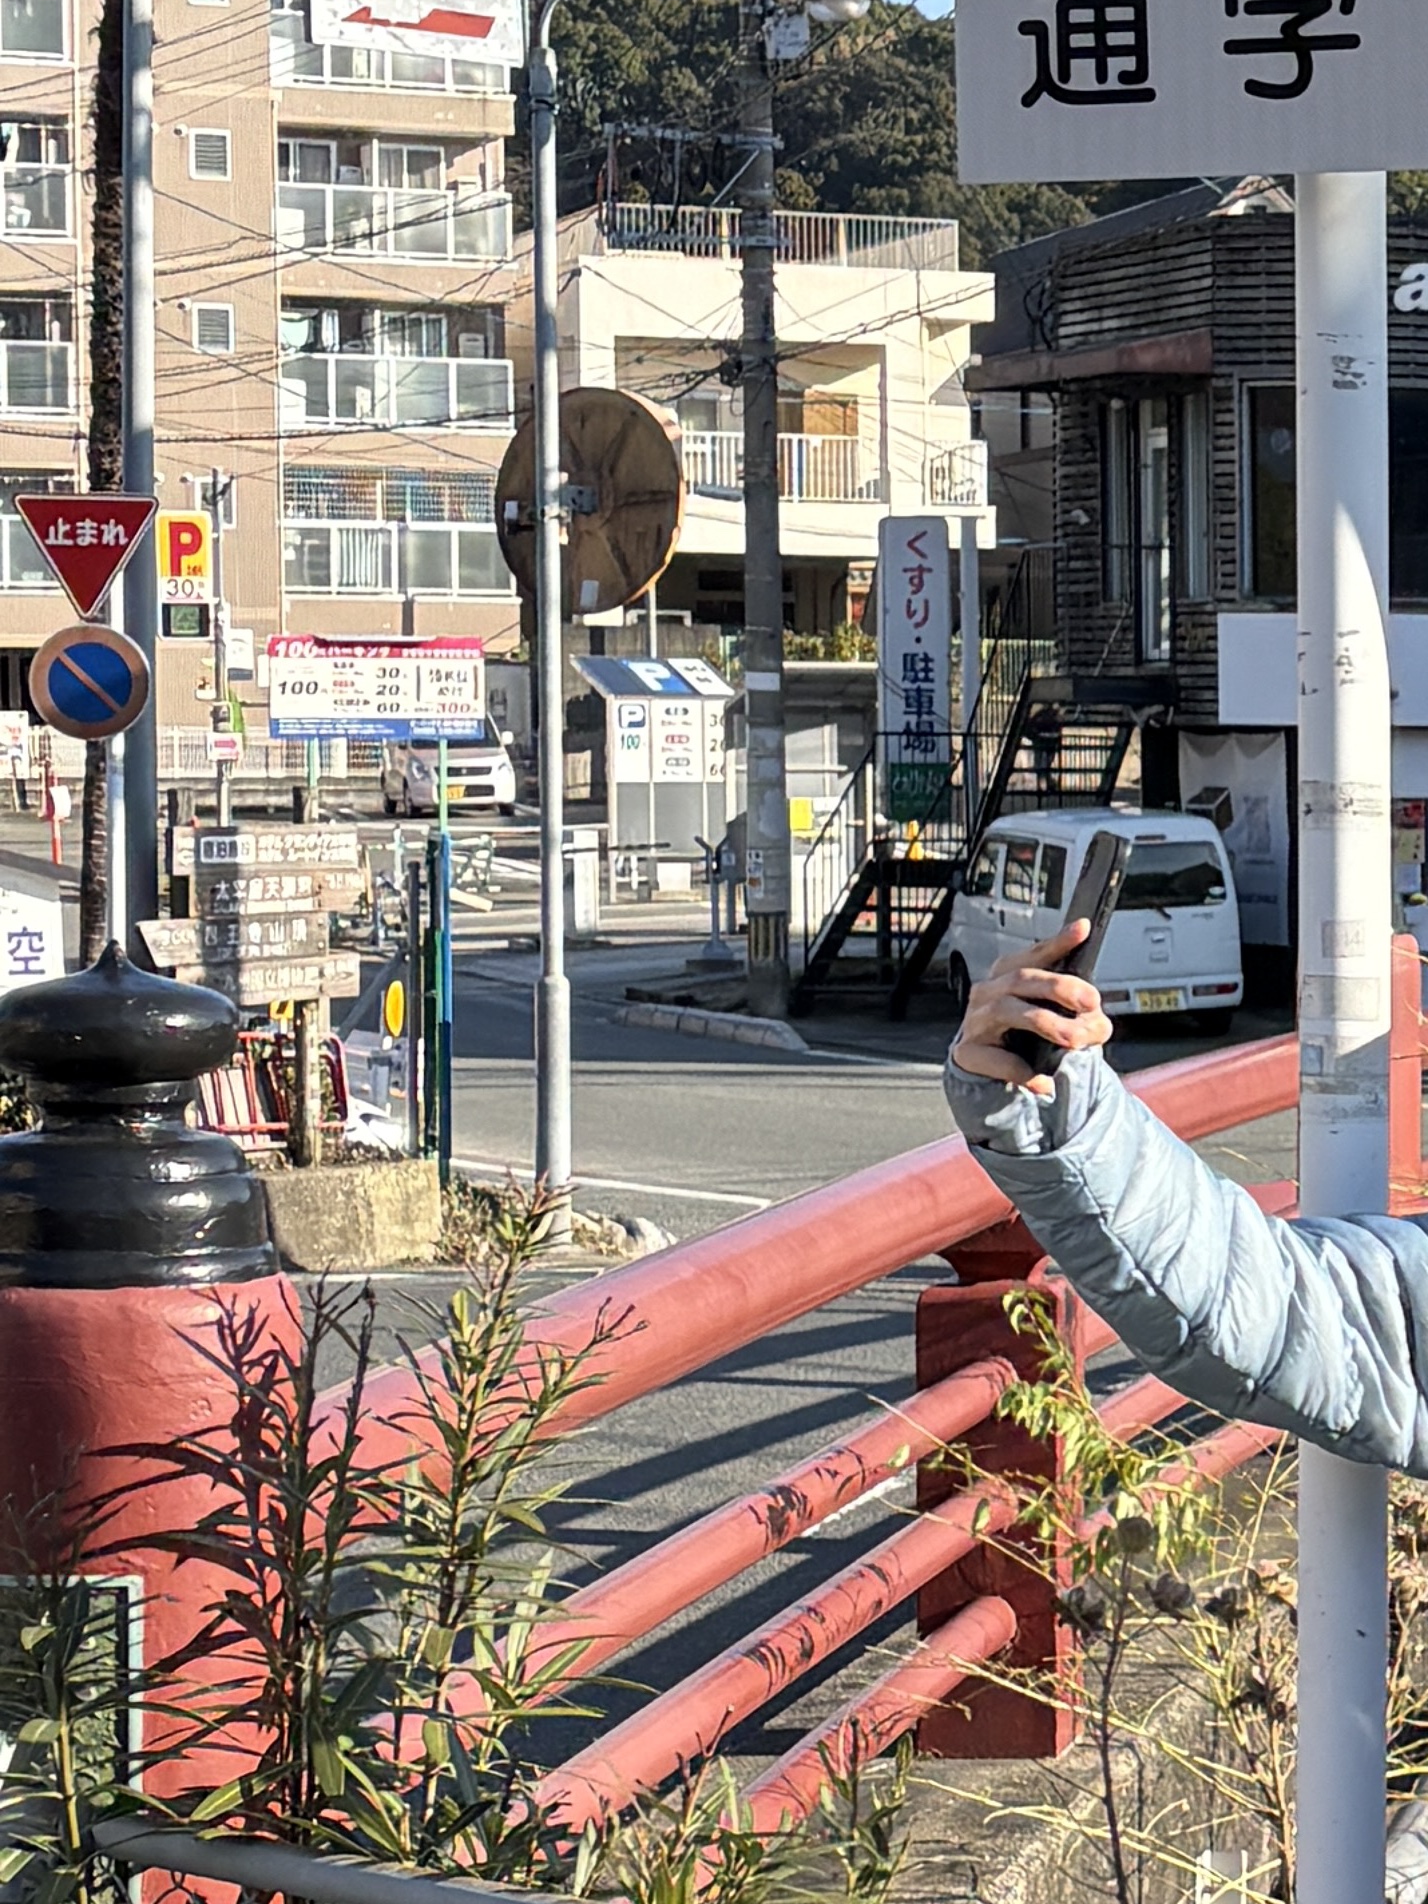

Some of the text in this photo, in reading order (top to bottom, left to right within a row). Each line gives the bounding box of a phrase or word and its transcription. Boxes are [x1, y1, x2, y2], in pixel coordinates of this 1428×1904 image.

[44, 517, 129, 546] 止まれ
[168, 521, 204, 577] P
[902, 529, 937, 754] くすり・駐車場
[277, 680, 319, 695] 100
[7, 926, 46, 976] 空
